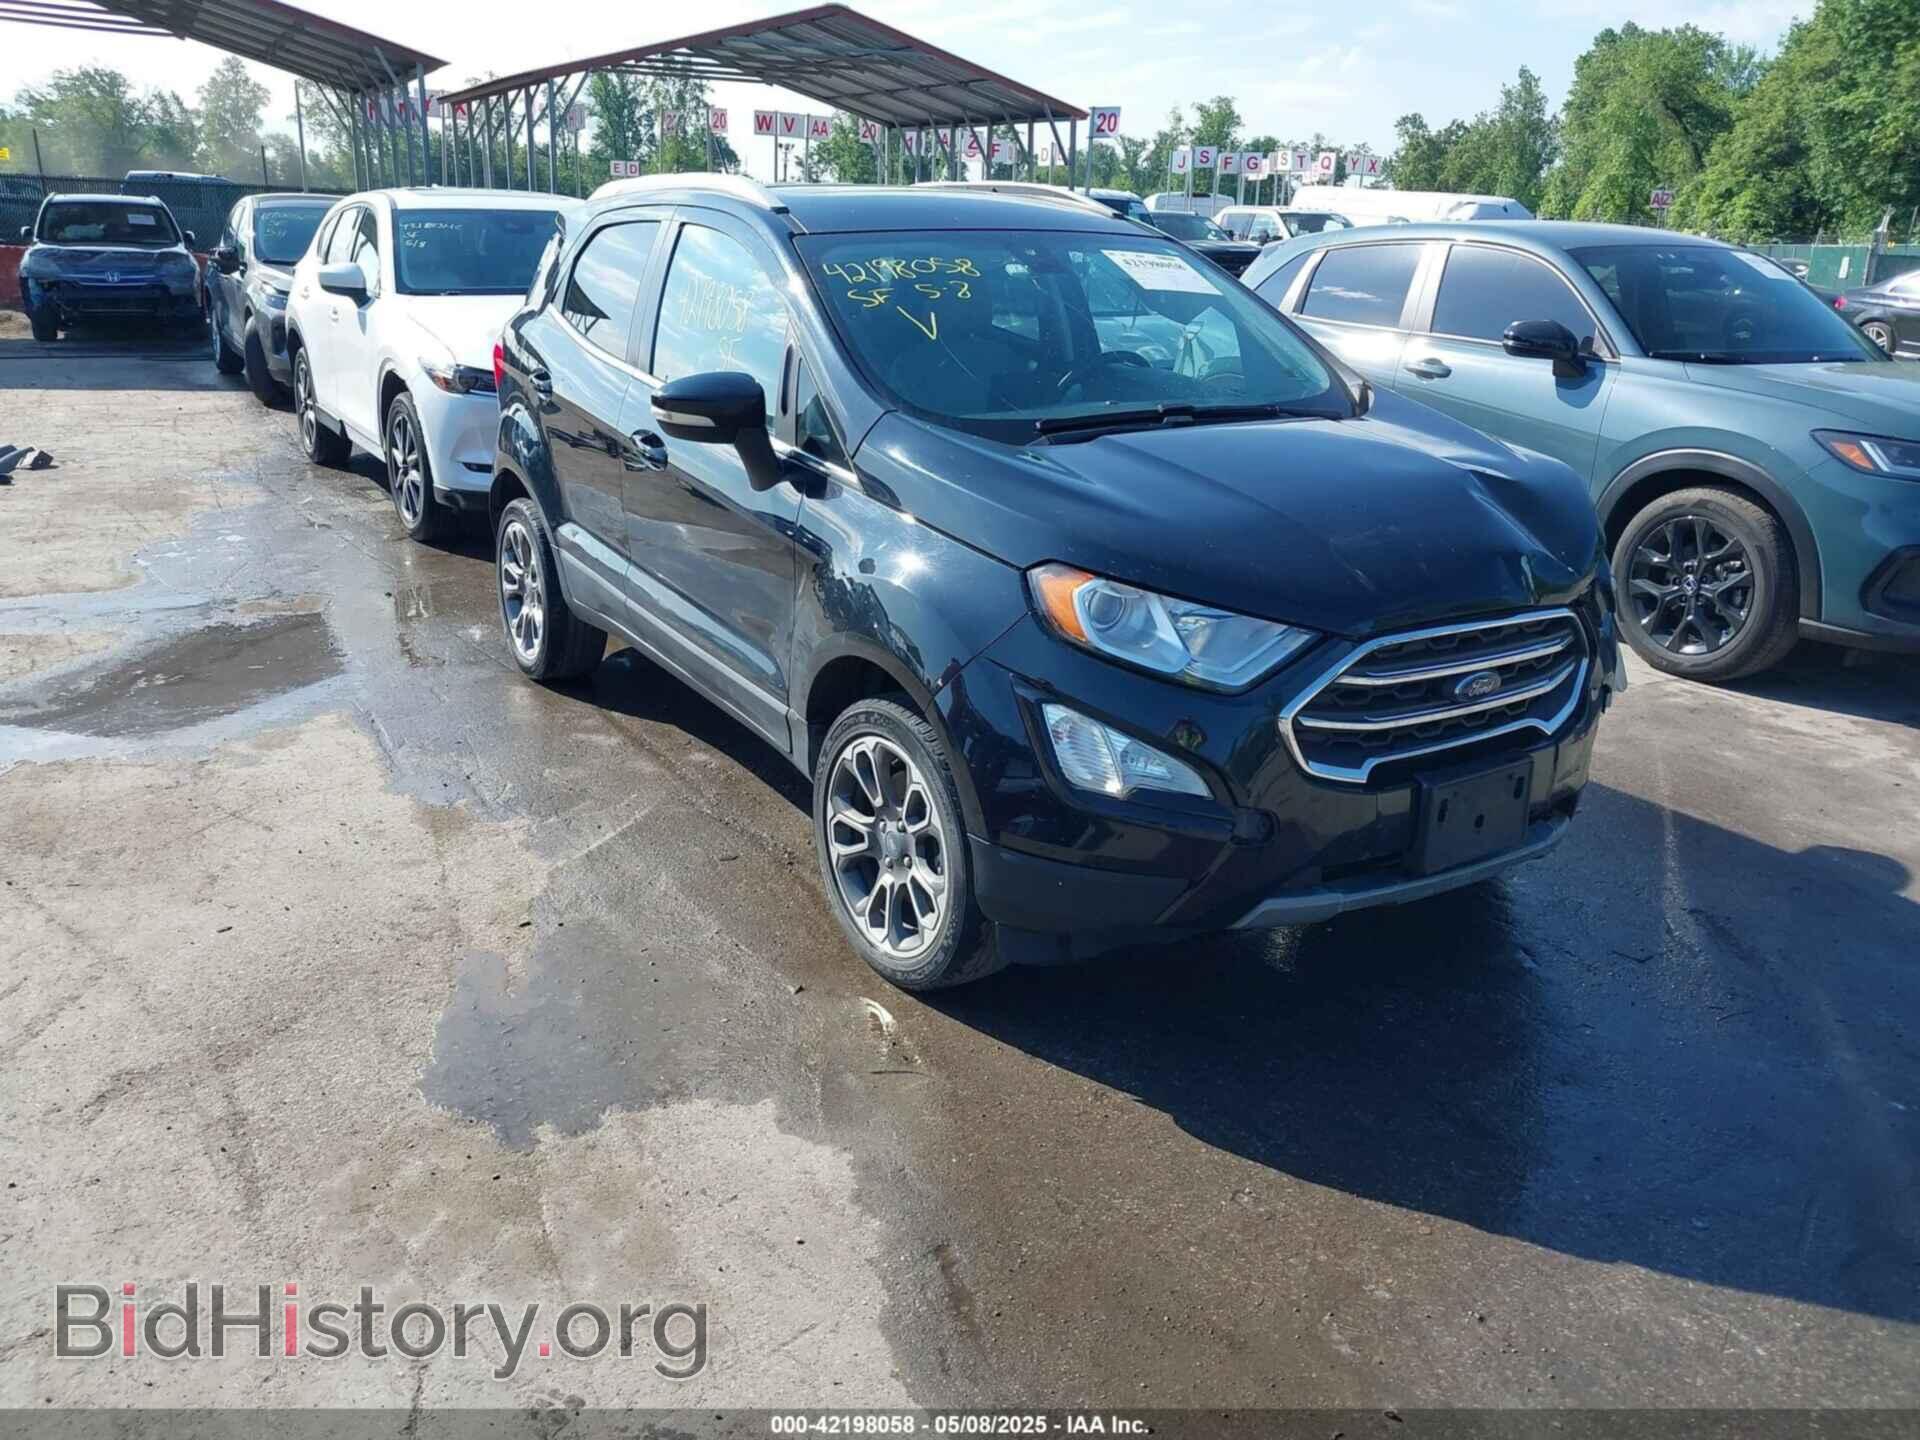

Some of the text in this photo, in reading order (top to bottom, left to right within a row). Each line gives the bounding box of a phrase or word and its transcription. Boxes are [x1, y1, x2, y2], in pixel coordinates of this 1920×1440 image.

[712, 112, 727, 129] 20
[756, 114, 829, 137] W V AA
[1096, 112, 1118, 133] 20
[1200, 150, 1210, 164] S
[1223, 156, 1258, 170] F G
[1296, 155, 1306, 168] T
[1320, 156, 1331, 171] Q
[613, 162, 638, 174] E D
[1367, 159, 1378, 172] X
[822, 257, 981, 284] 42198058
[848, 288, 895, 307] SF
